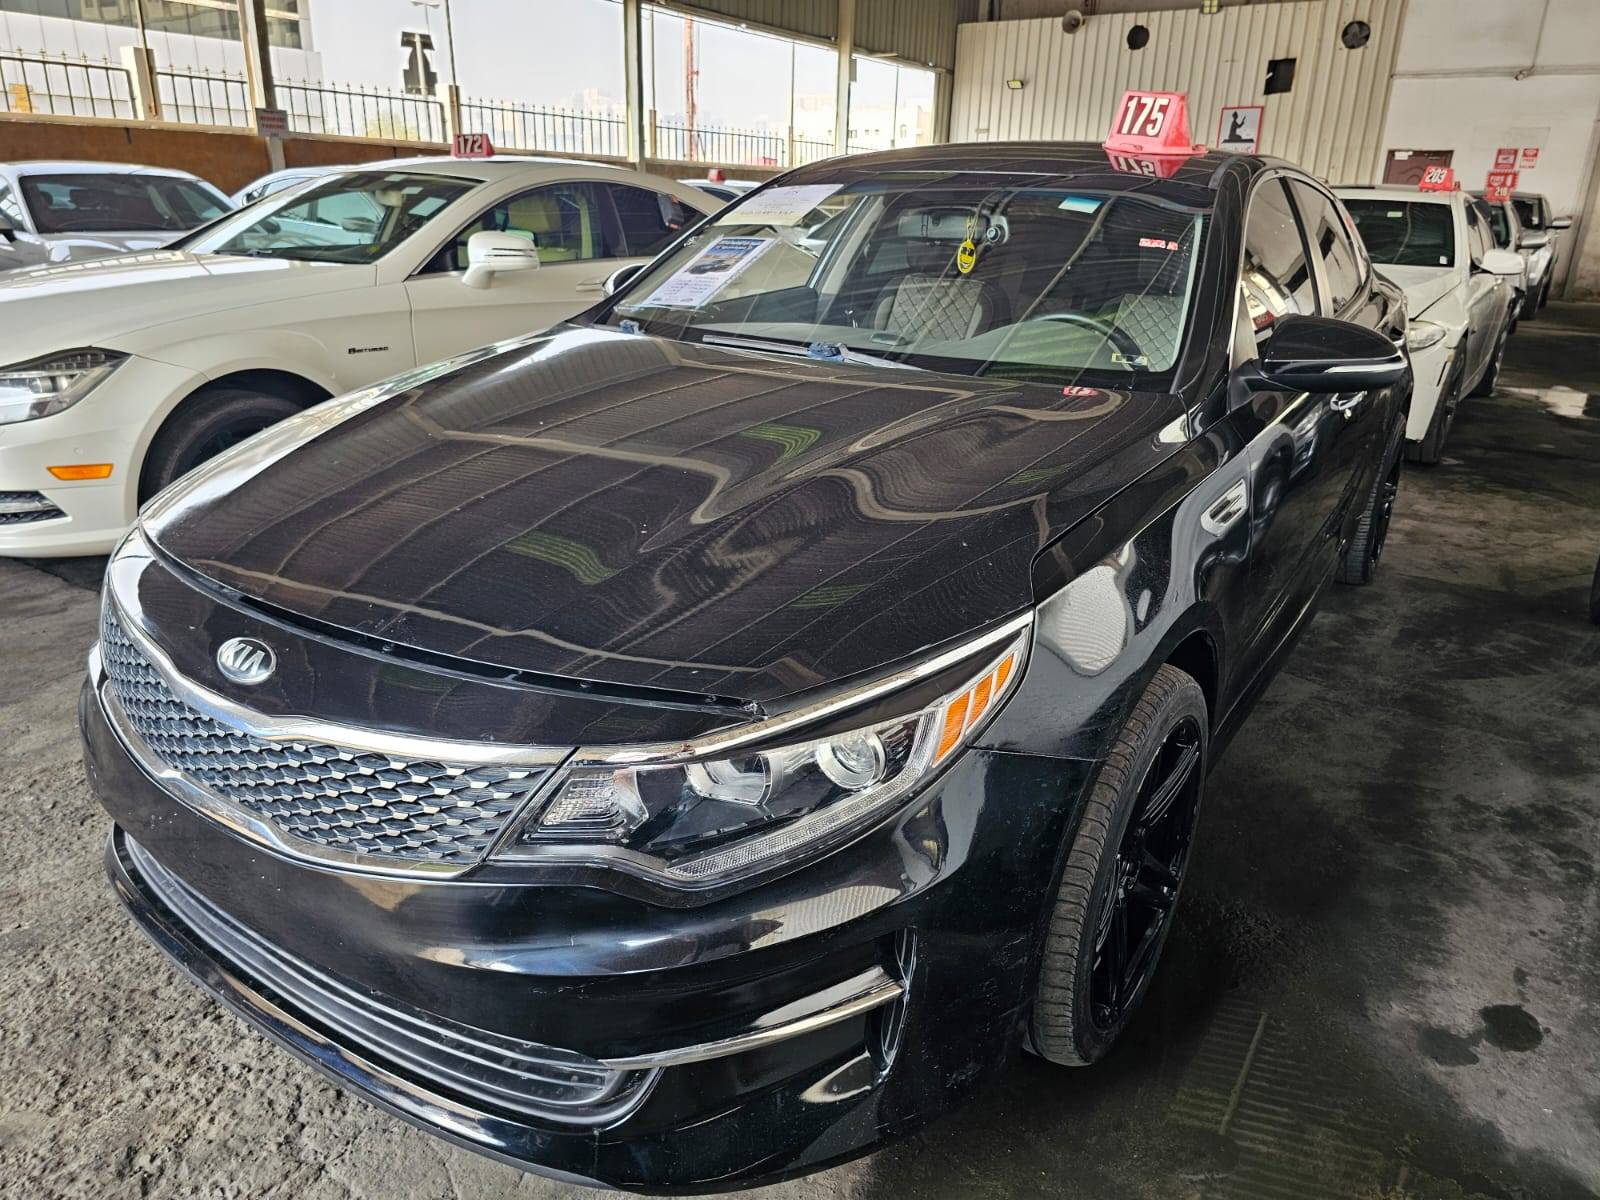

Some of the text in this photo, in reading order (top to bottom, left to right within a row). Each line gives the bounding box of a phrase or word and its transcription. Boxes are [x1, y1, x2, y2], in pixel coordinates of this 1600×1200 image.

[1122, 97, 1169, 136] 175
[459, 135, 482, 154] 172
[1424, 167, 1448, 184] 203
[222, 642, 266, 676] KIA
